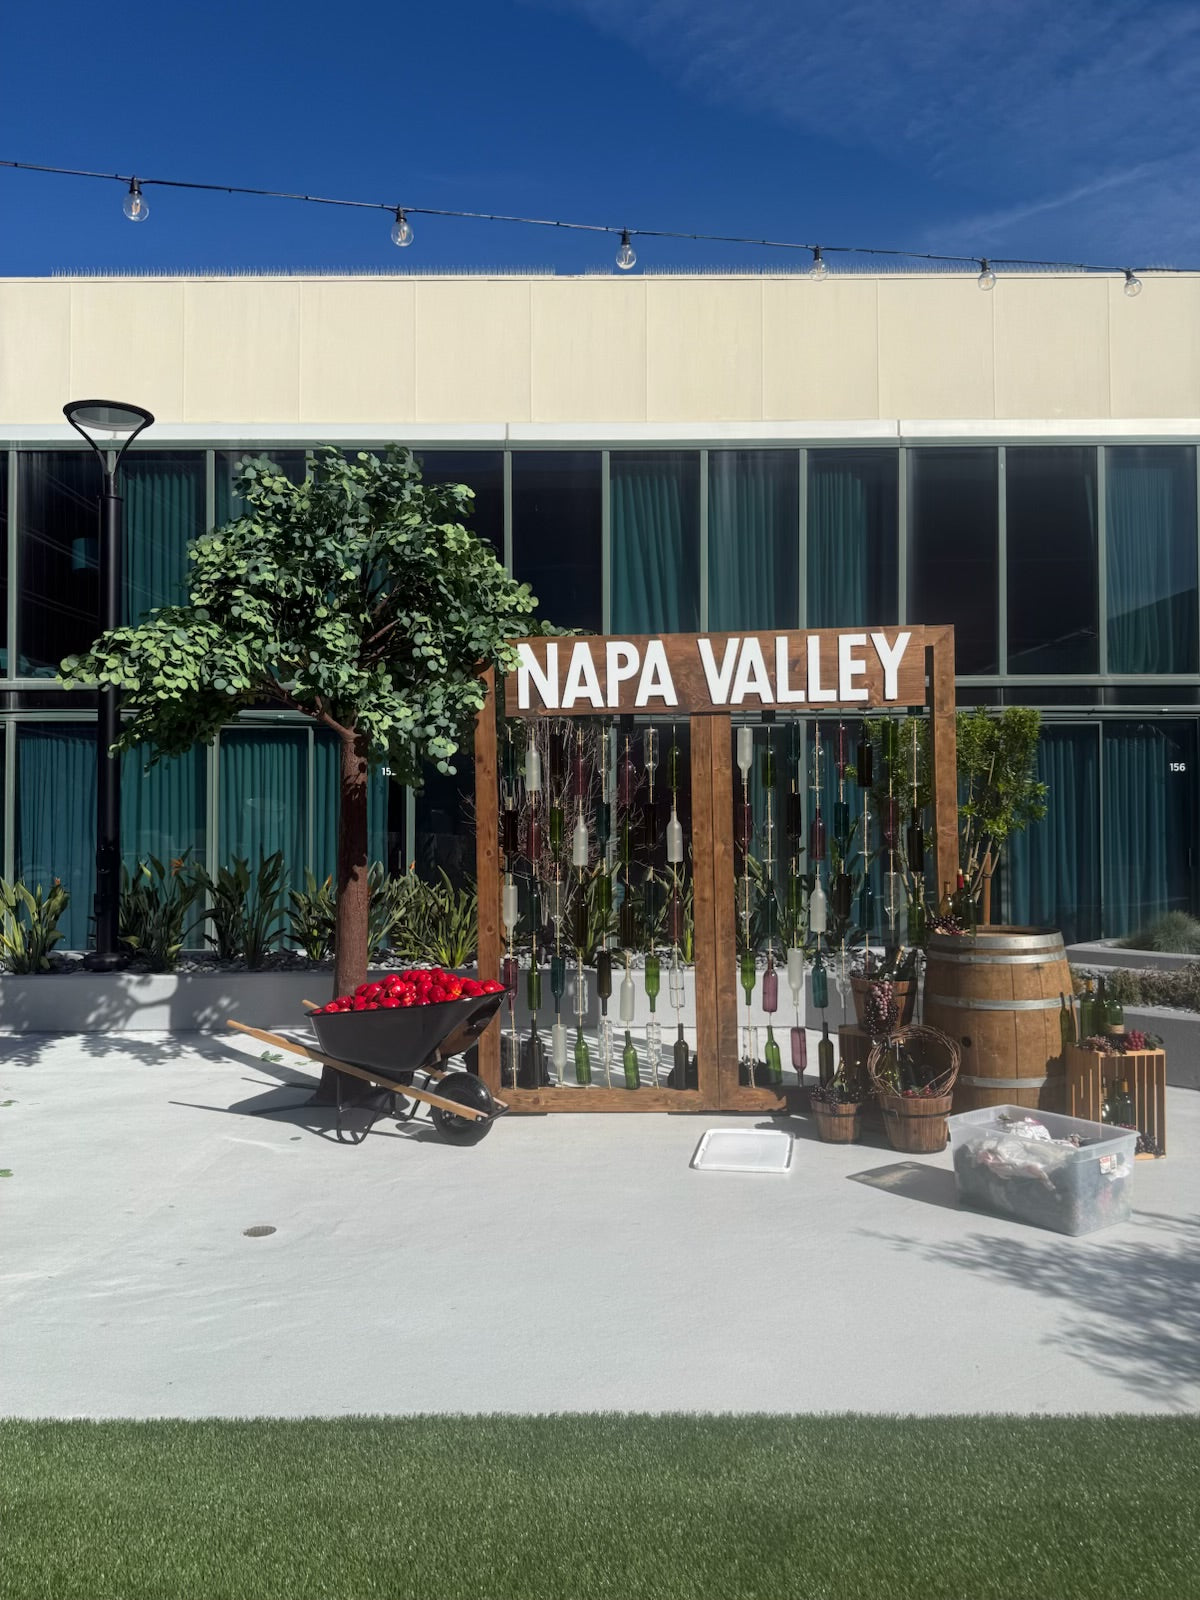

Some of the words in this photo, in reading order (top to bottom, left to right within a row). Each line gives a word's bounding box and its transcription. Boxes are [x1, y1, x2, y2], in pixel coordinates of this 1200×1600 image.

[517, 640, 678, 709] NAPA
[697, 632, 911, 704] VALLEY
[382, 767, 397, 776] 15
[1169, 762, 1186, 772] 156
